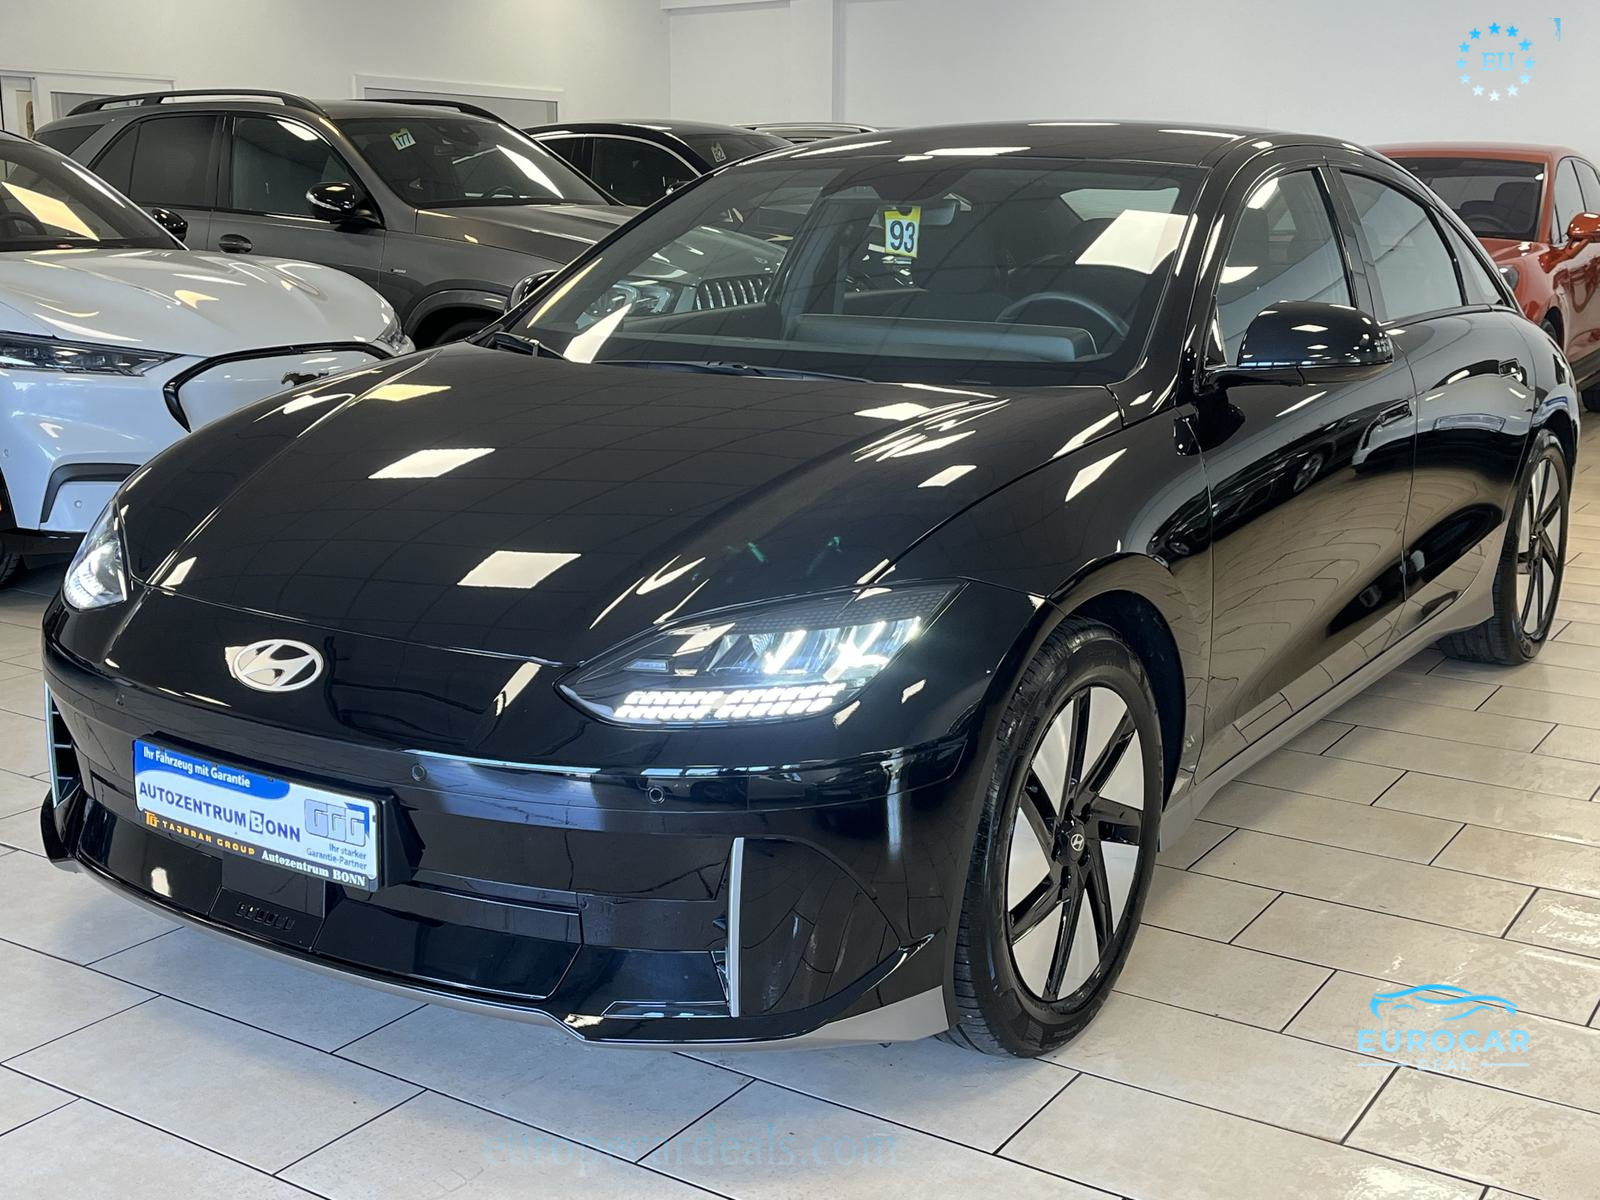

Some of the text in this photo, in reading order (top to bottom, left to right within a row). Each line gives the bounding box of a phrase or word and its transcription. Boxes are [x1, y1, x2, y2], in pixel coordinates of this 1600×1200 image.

[396, 133, 411, 147] 177
[890, 220, 915, 253] 93
[143, 746, 251, 788] Ihr Fahrzeug mit Garantie
[216, 838, 255, 855] GROUP
[329, 843, 367, 859] Ihr starker
[262, 850, 366, 887] Autozentrum BONN
[306, 848, 367, 870] Garantie-Partner
